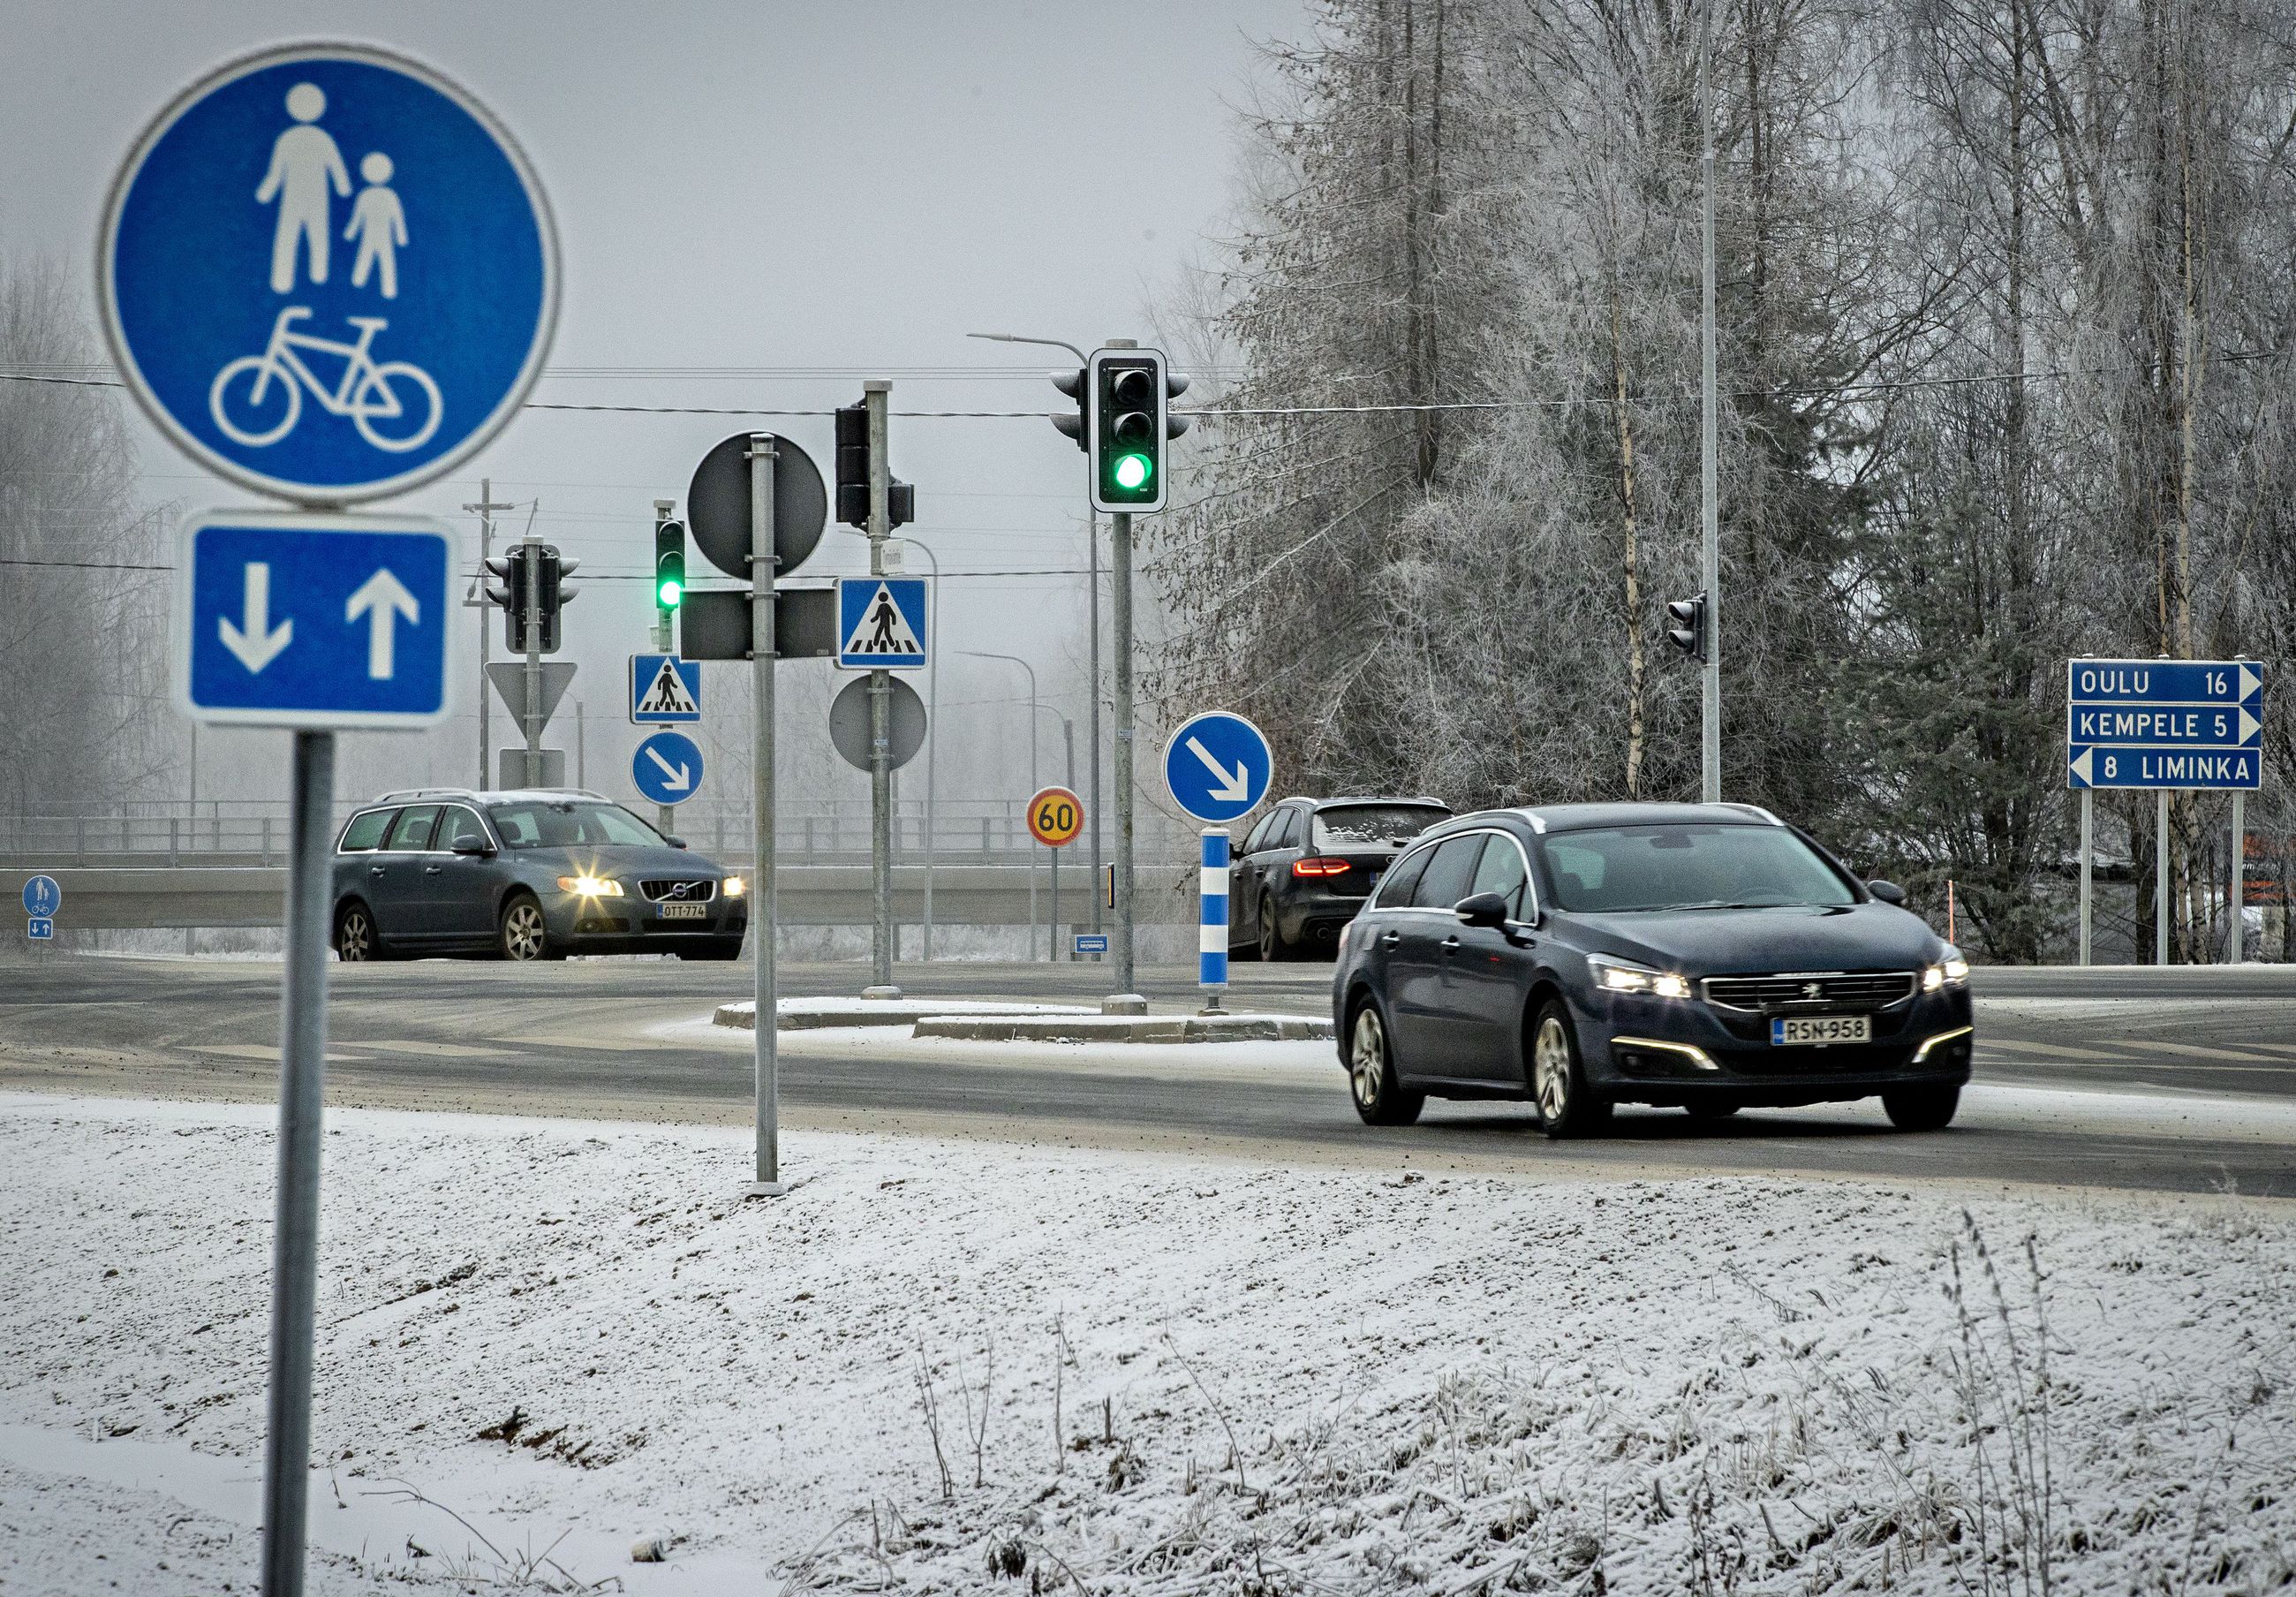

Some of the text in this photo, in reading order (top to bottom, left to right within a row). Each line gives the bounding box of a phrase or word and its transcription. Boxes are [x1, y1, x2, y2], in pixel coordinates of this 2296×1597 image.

[2081, 670, 2227, 694] OULU 16
[2081, 713, 2227, 738] KEMPELE 5
[2104, 755, 2250, 780] 8 LIMINKA
[1038, 803, 1073, 831] 60
[664, 906, 704, 917] OTT-774
[1786, 1020, 1864, 1041] RSN-958
